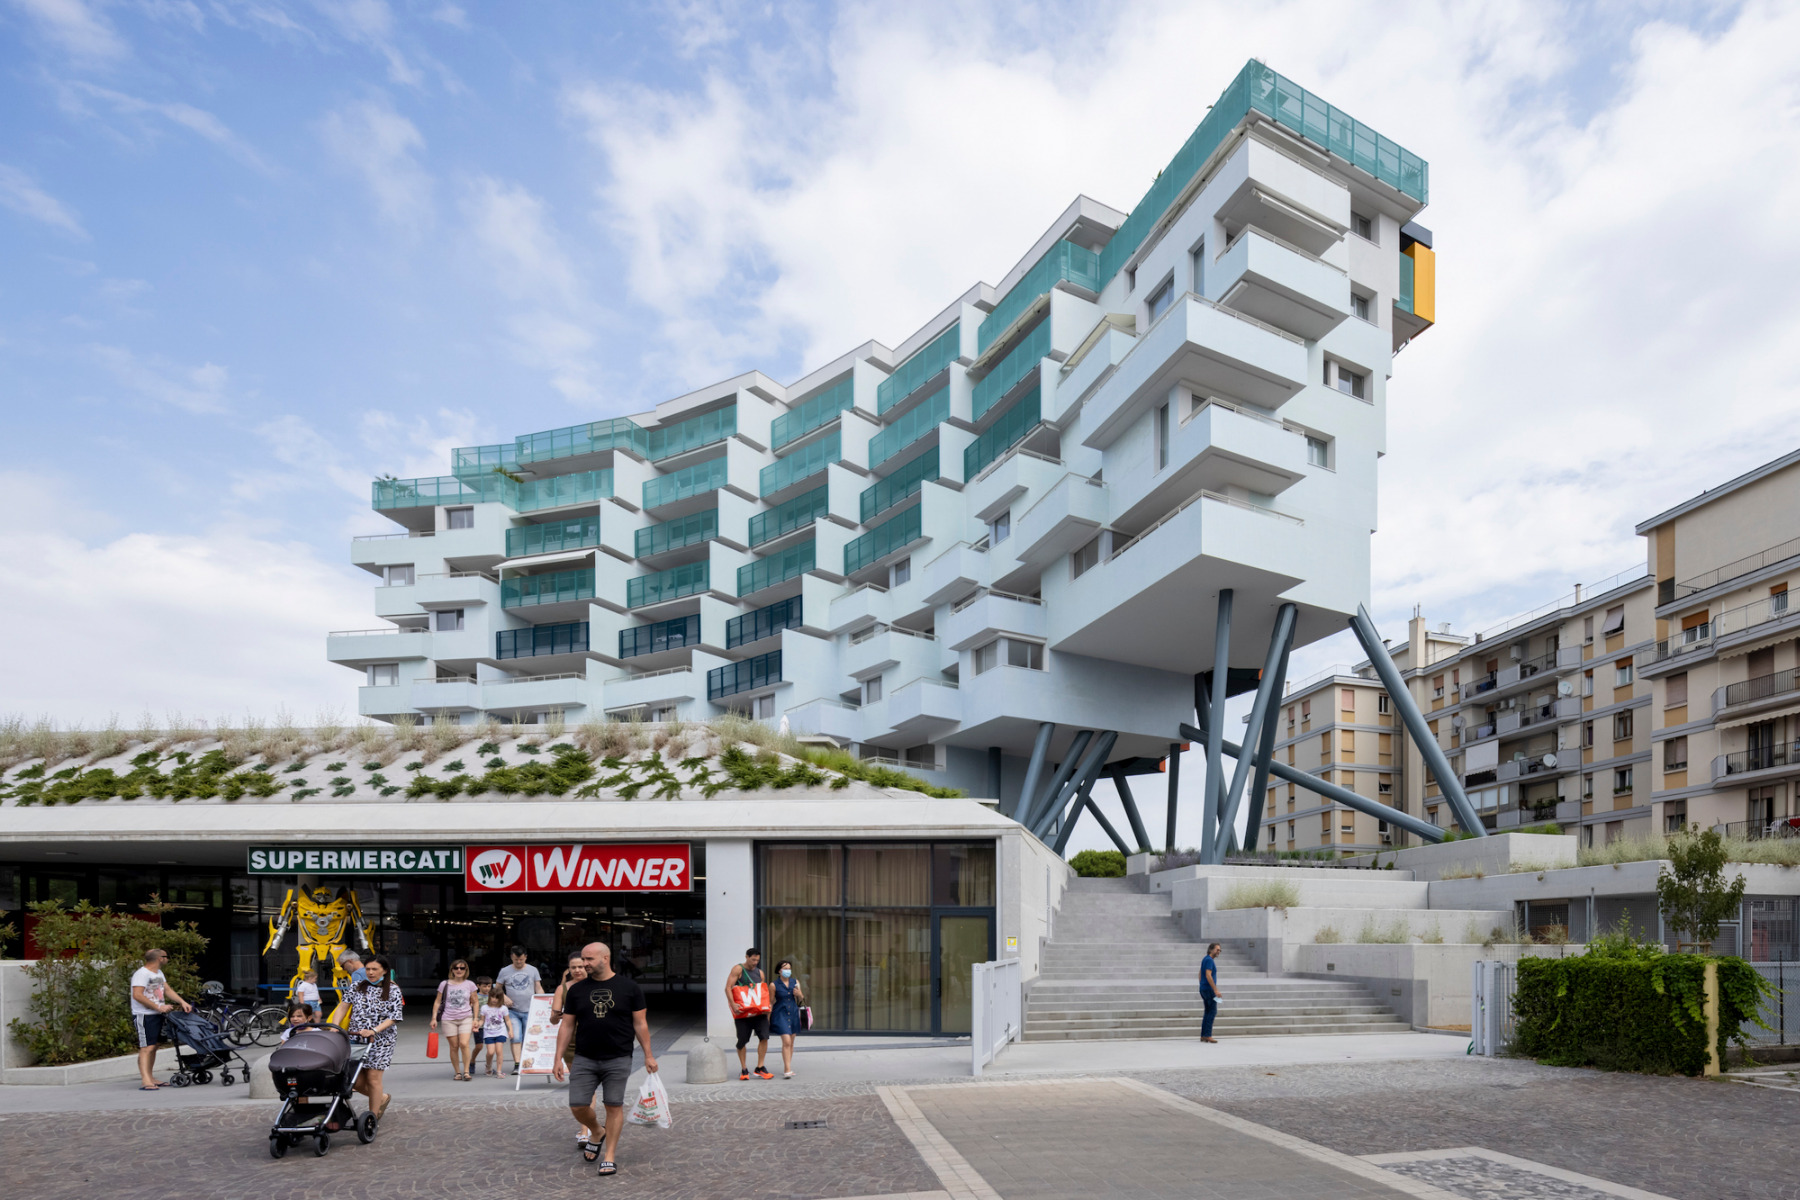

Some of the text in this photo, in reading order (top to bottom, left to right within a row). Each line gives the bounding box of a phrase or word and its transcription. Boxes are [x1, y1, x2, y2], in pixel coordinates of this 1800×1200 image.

[251, 850, 459, 870] SUPERMERCATI
[533, 844, 686, 888] WINNER
[740, 982, 762, 1007] W
